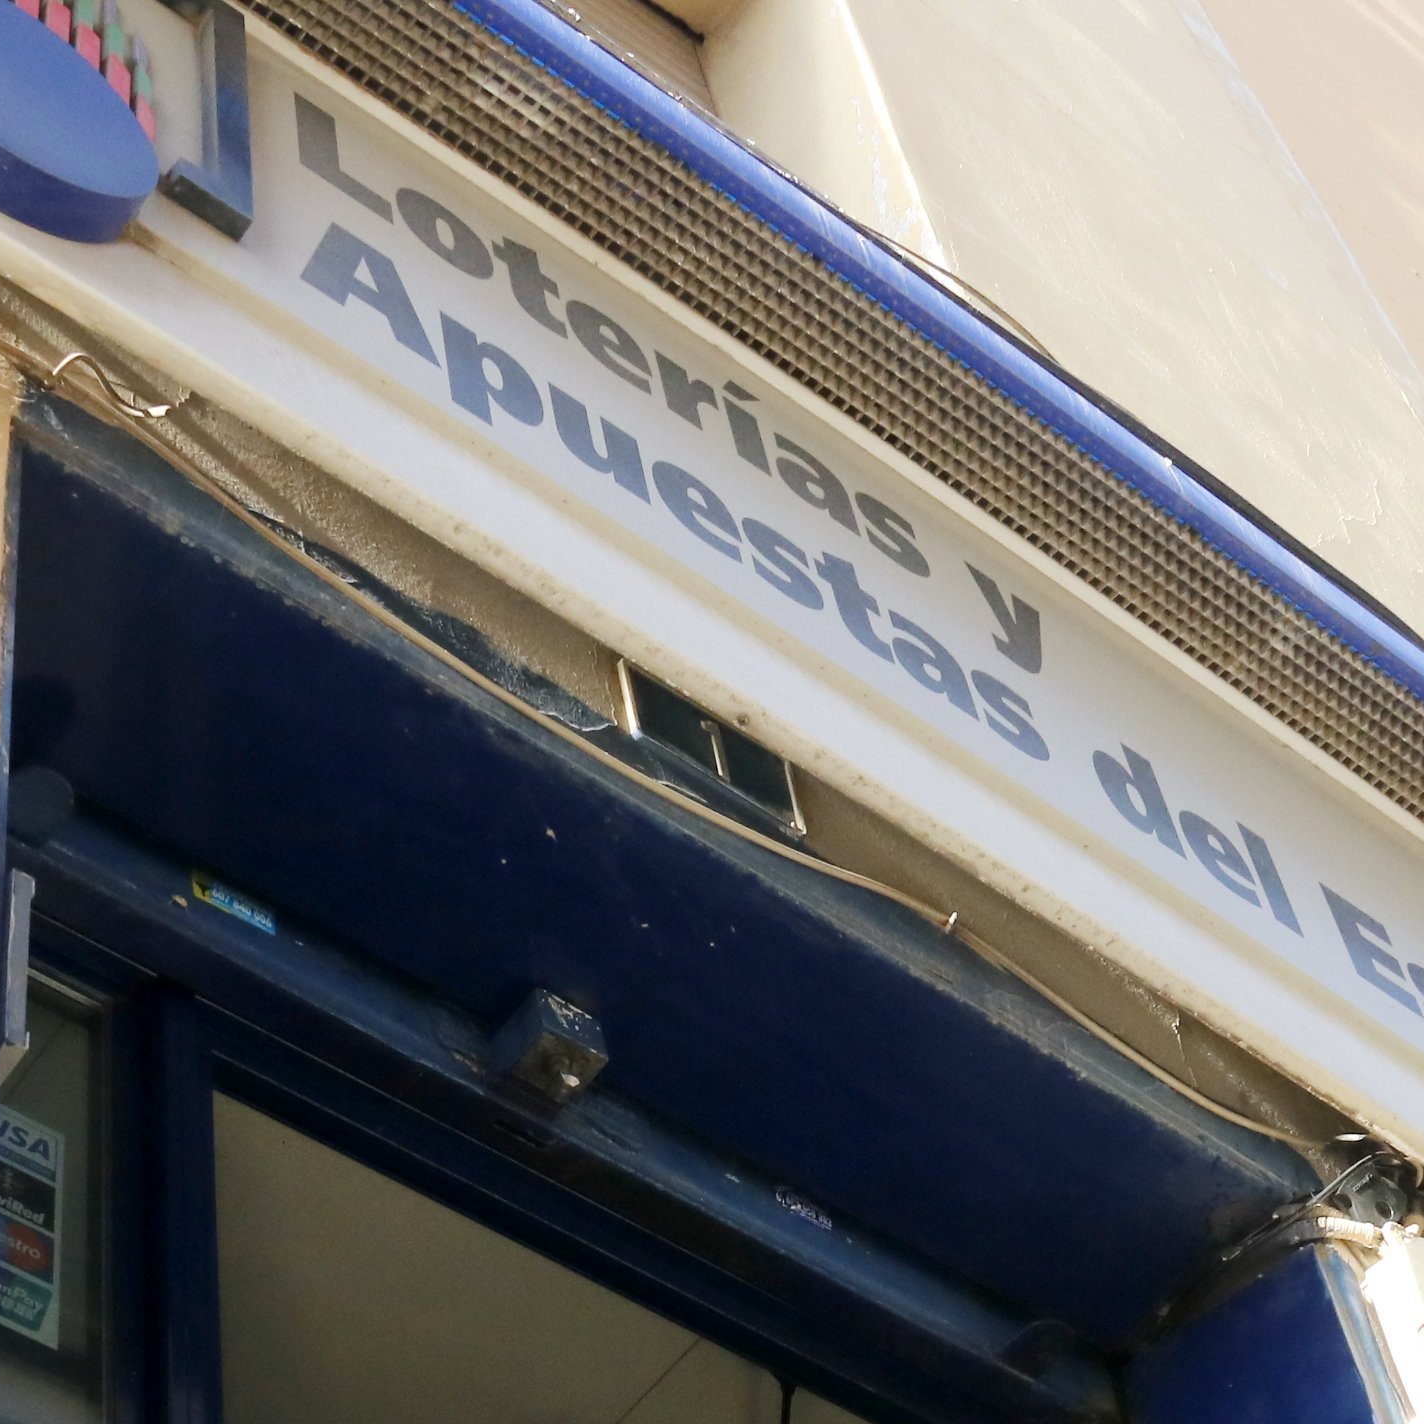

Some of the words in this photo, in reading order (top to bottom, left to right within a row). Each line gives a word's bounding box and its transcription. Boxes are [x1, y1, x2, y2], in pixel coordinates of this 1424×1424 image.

[293, 92, 932, 580] Loterías
[965, 562, 1043, 673] y
[301, 223, 1049, 760] Apuestas
[1093, 744, 1303, 938] del
